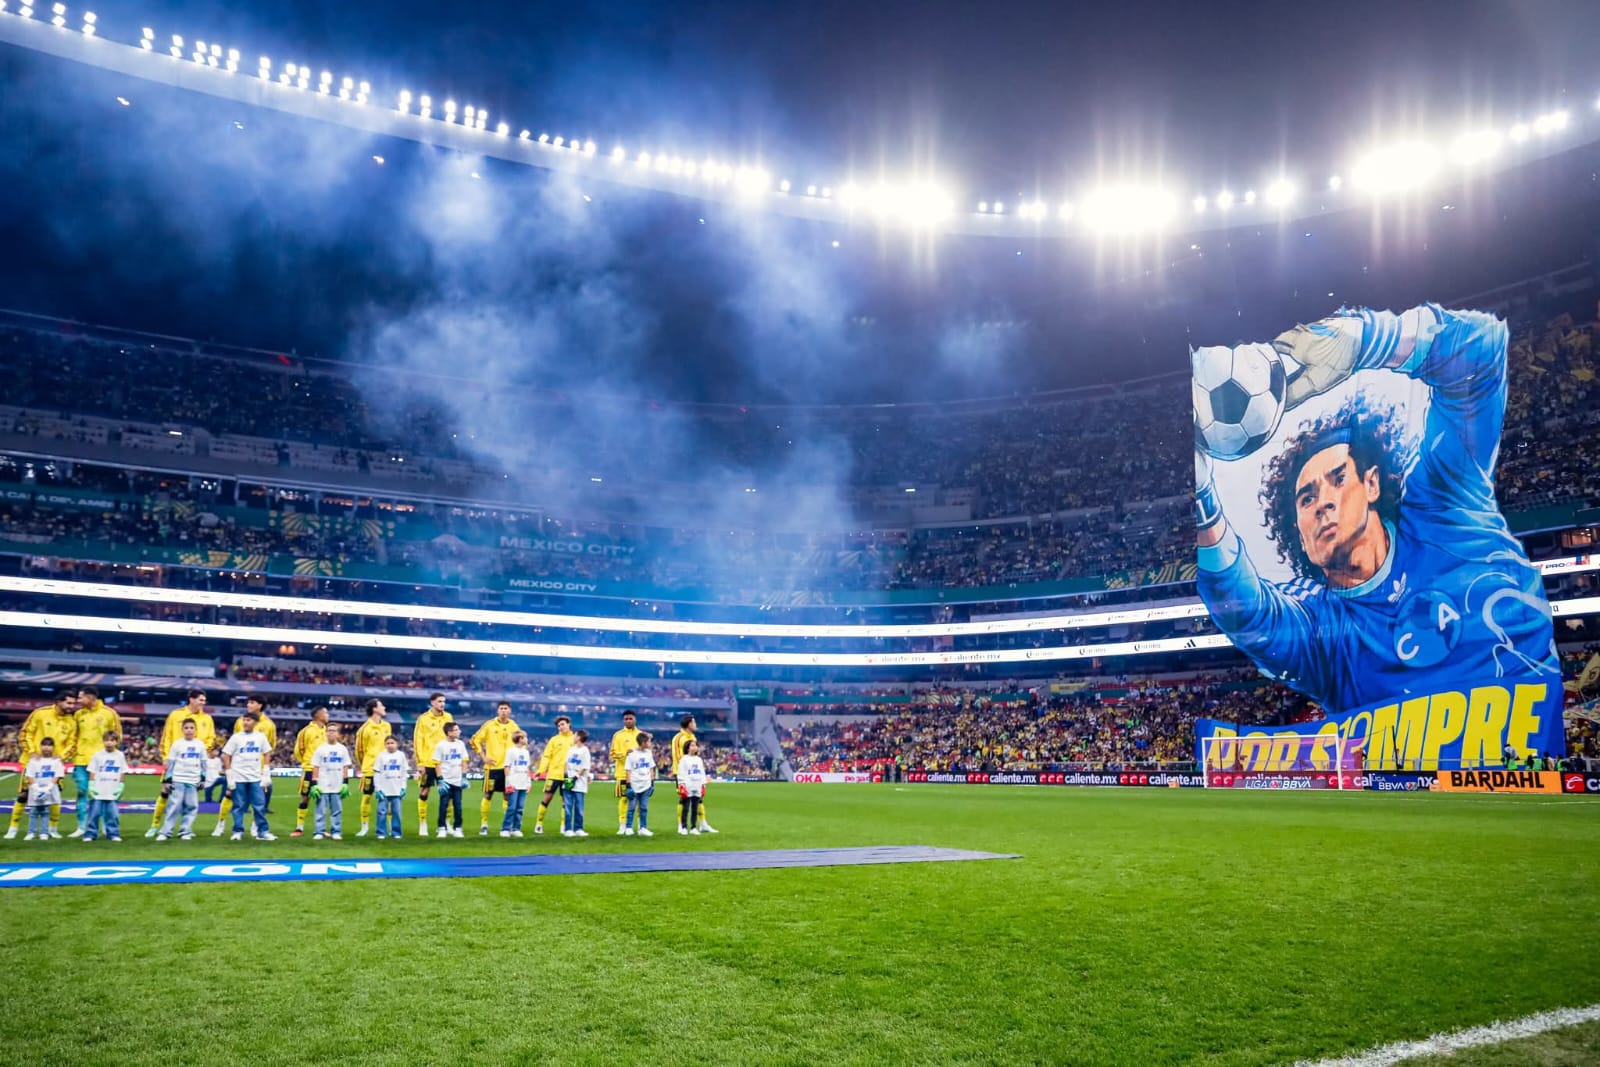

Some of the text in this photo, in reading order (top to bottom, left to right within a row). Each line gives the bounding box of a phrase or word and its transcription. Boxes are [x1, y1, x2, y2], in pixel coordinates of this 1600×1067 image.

[500, 535, 636, 557] MEXICO CITY
[509, 578, 597, 592] MEXICO CITY
[927, 773, 966, 784] caliente.mx
[989, 773, 1037, 784] caliente.mx
[1064, 772, 1117, 785] caliente.mx
[1245, 780, 1312, 789] LIGA BBVA
[1450, 771, 1545, 790] BARDAHL
[1378, 782, 1405, 790] BBVA
[0, 861, 384, 881] ICIÓN
